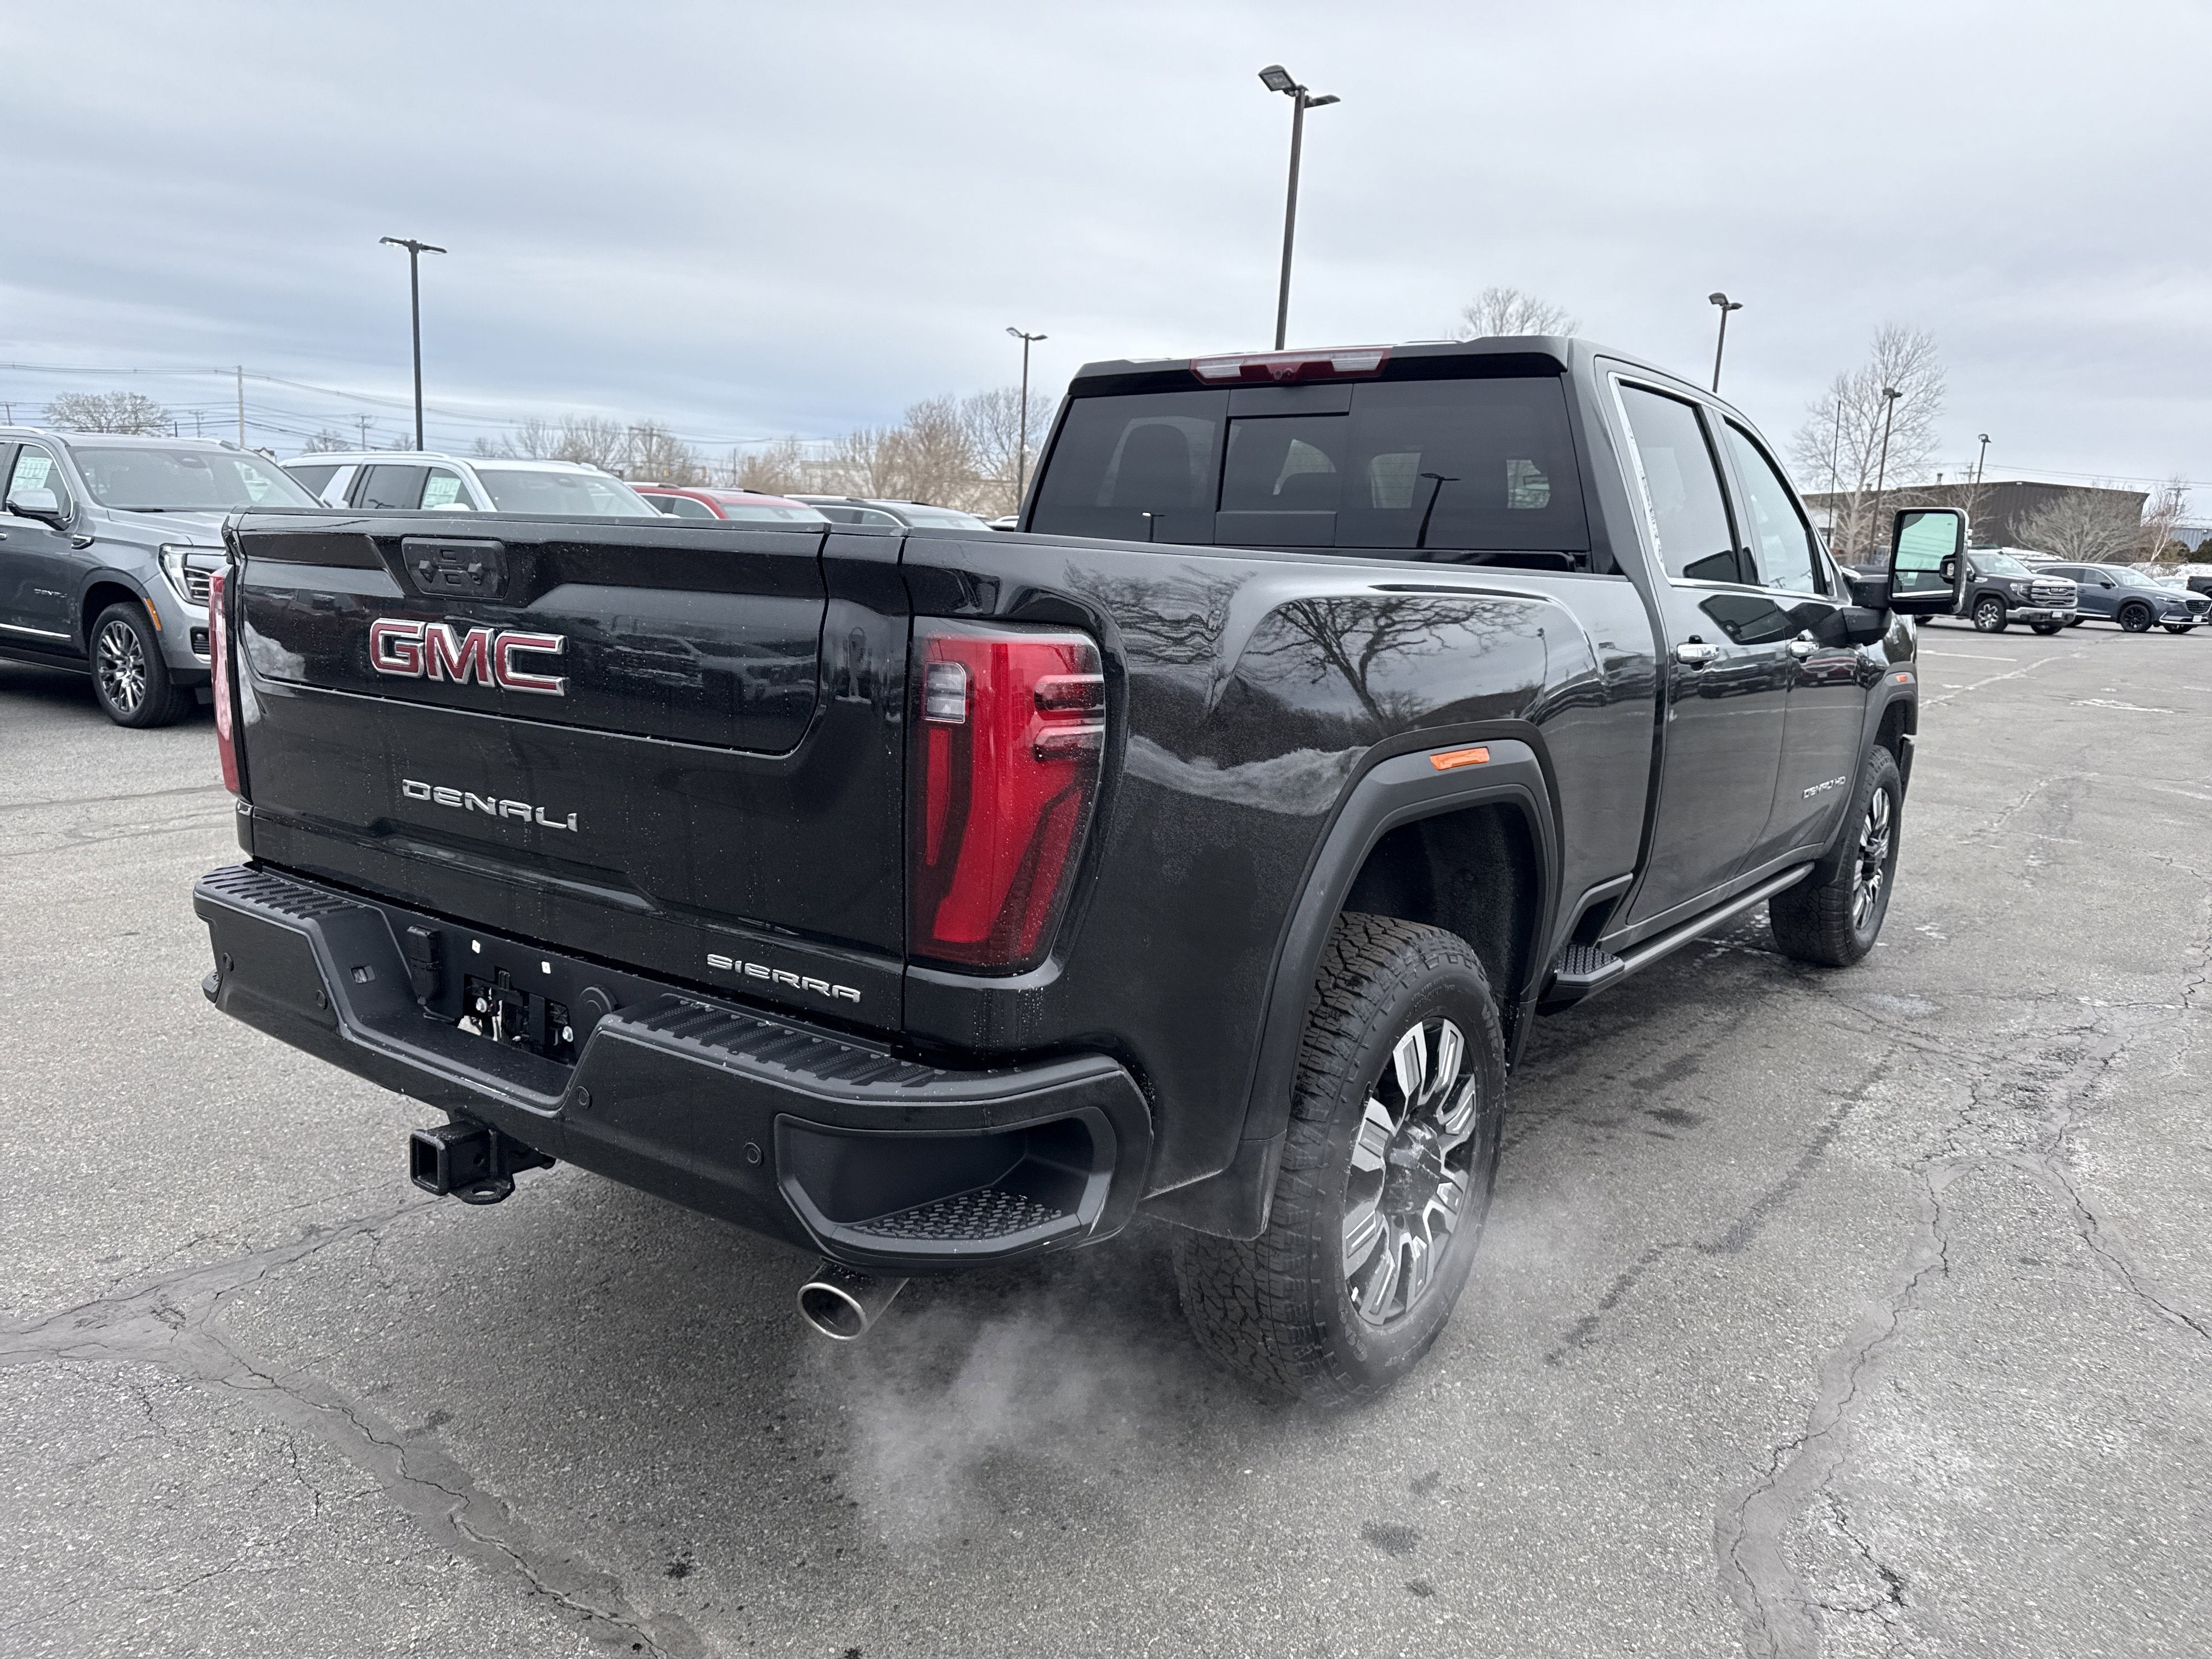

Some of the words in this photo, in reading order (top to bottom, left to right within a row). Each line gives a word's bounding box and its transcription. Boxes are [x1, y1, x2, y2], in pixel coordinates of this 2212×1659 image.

[370, 618, 567, 697] GMC
[402, 778, 578, 832] DENALI
[707, 953, 861, 1003] SIERRA
